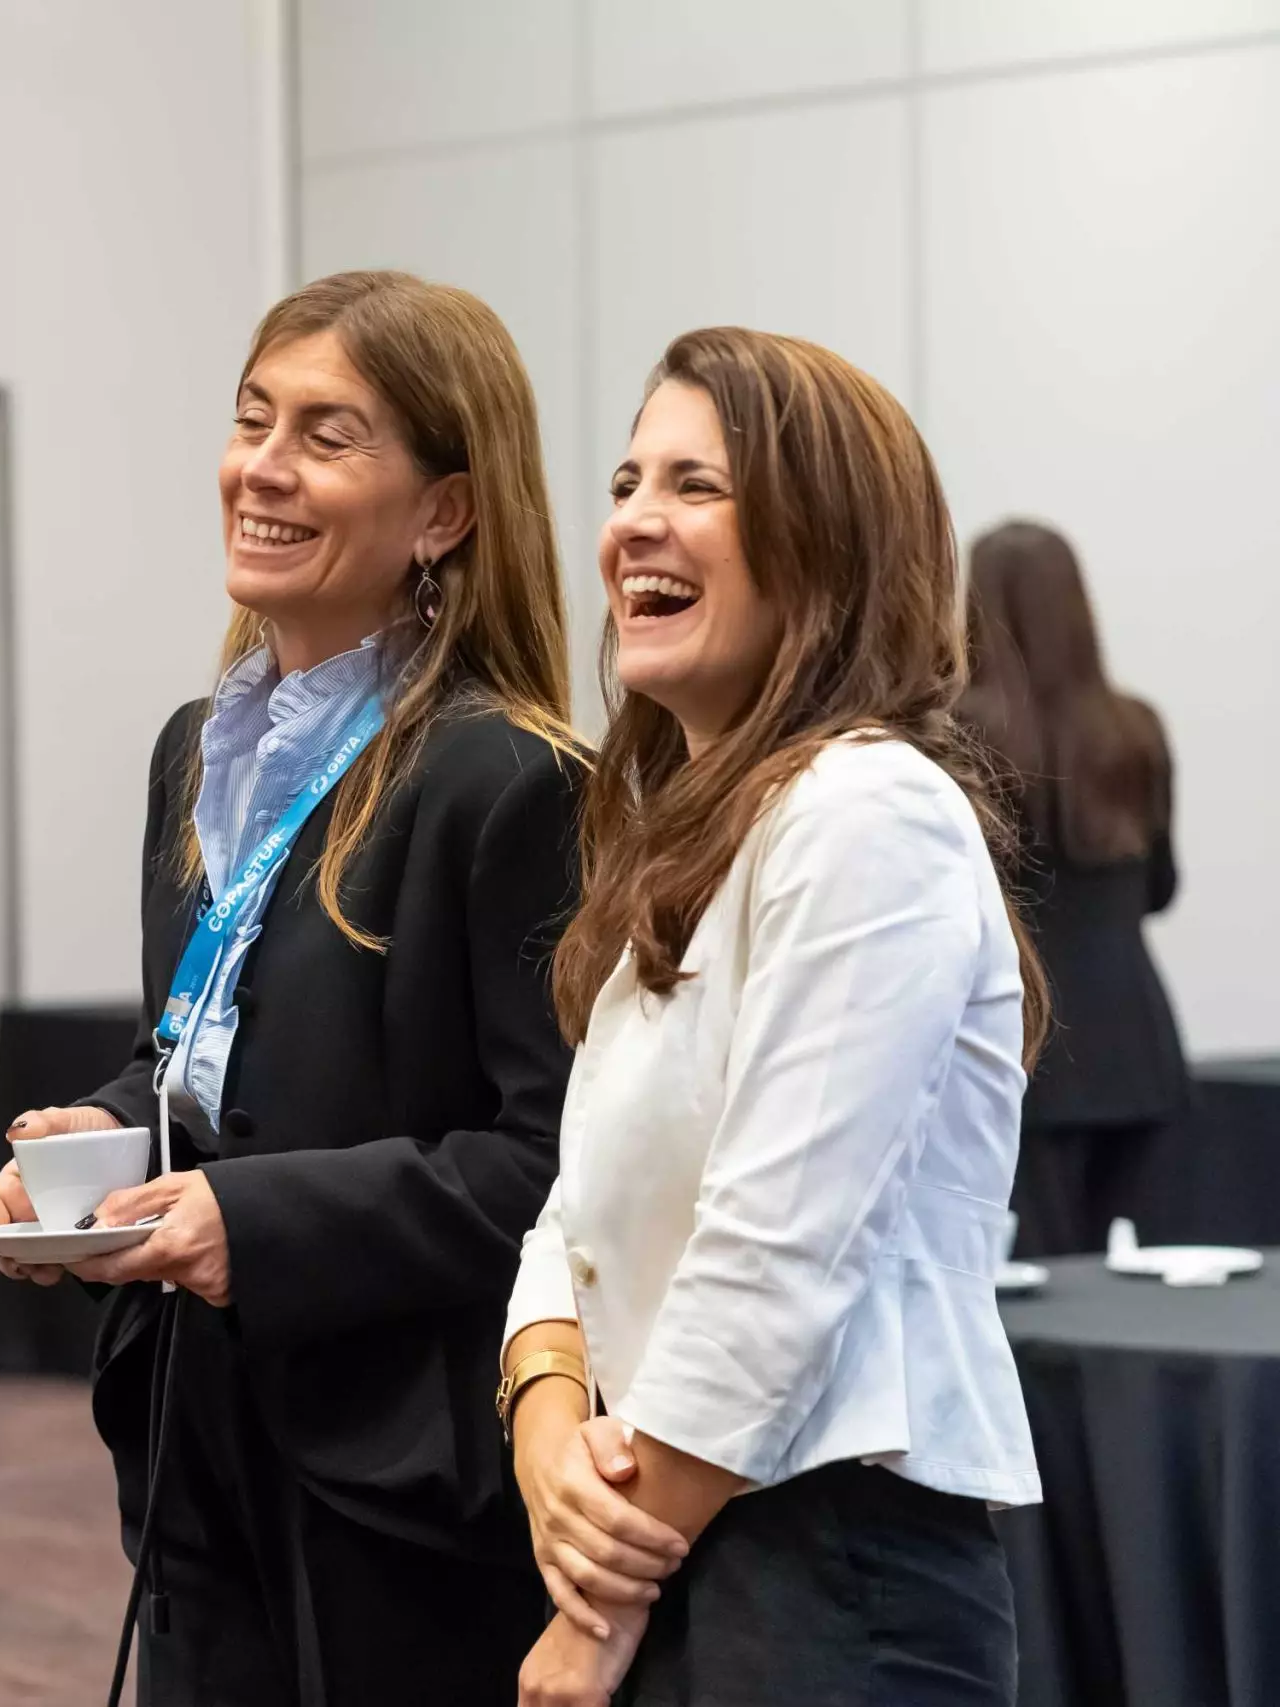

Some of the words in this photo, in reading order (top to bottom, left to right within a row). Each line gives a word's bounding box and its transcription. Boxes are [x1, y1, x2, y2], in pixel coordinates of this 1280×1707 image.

[327, 736, 361, 774] GBTA
[208, 830, 285, 932] COPASTUR
[169, 991, 194, 1034] GBA
